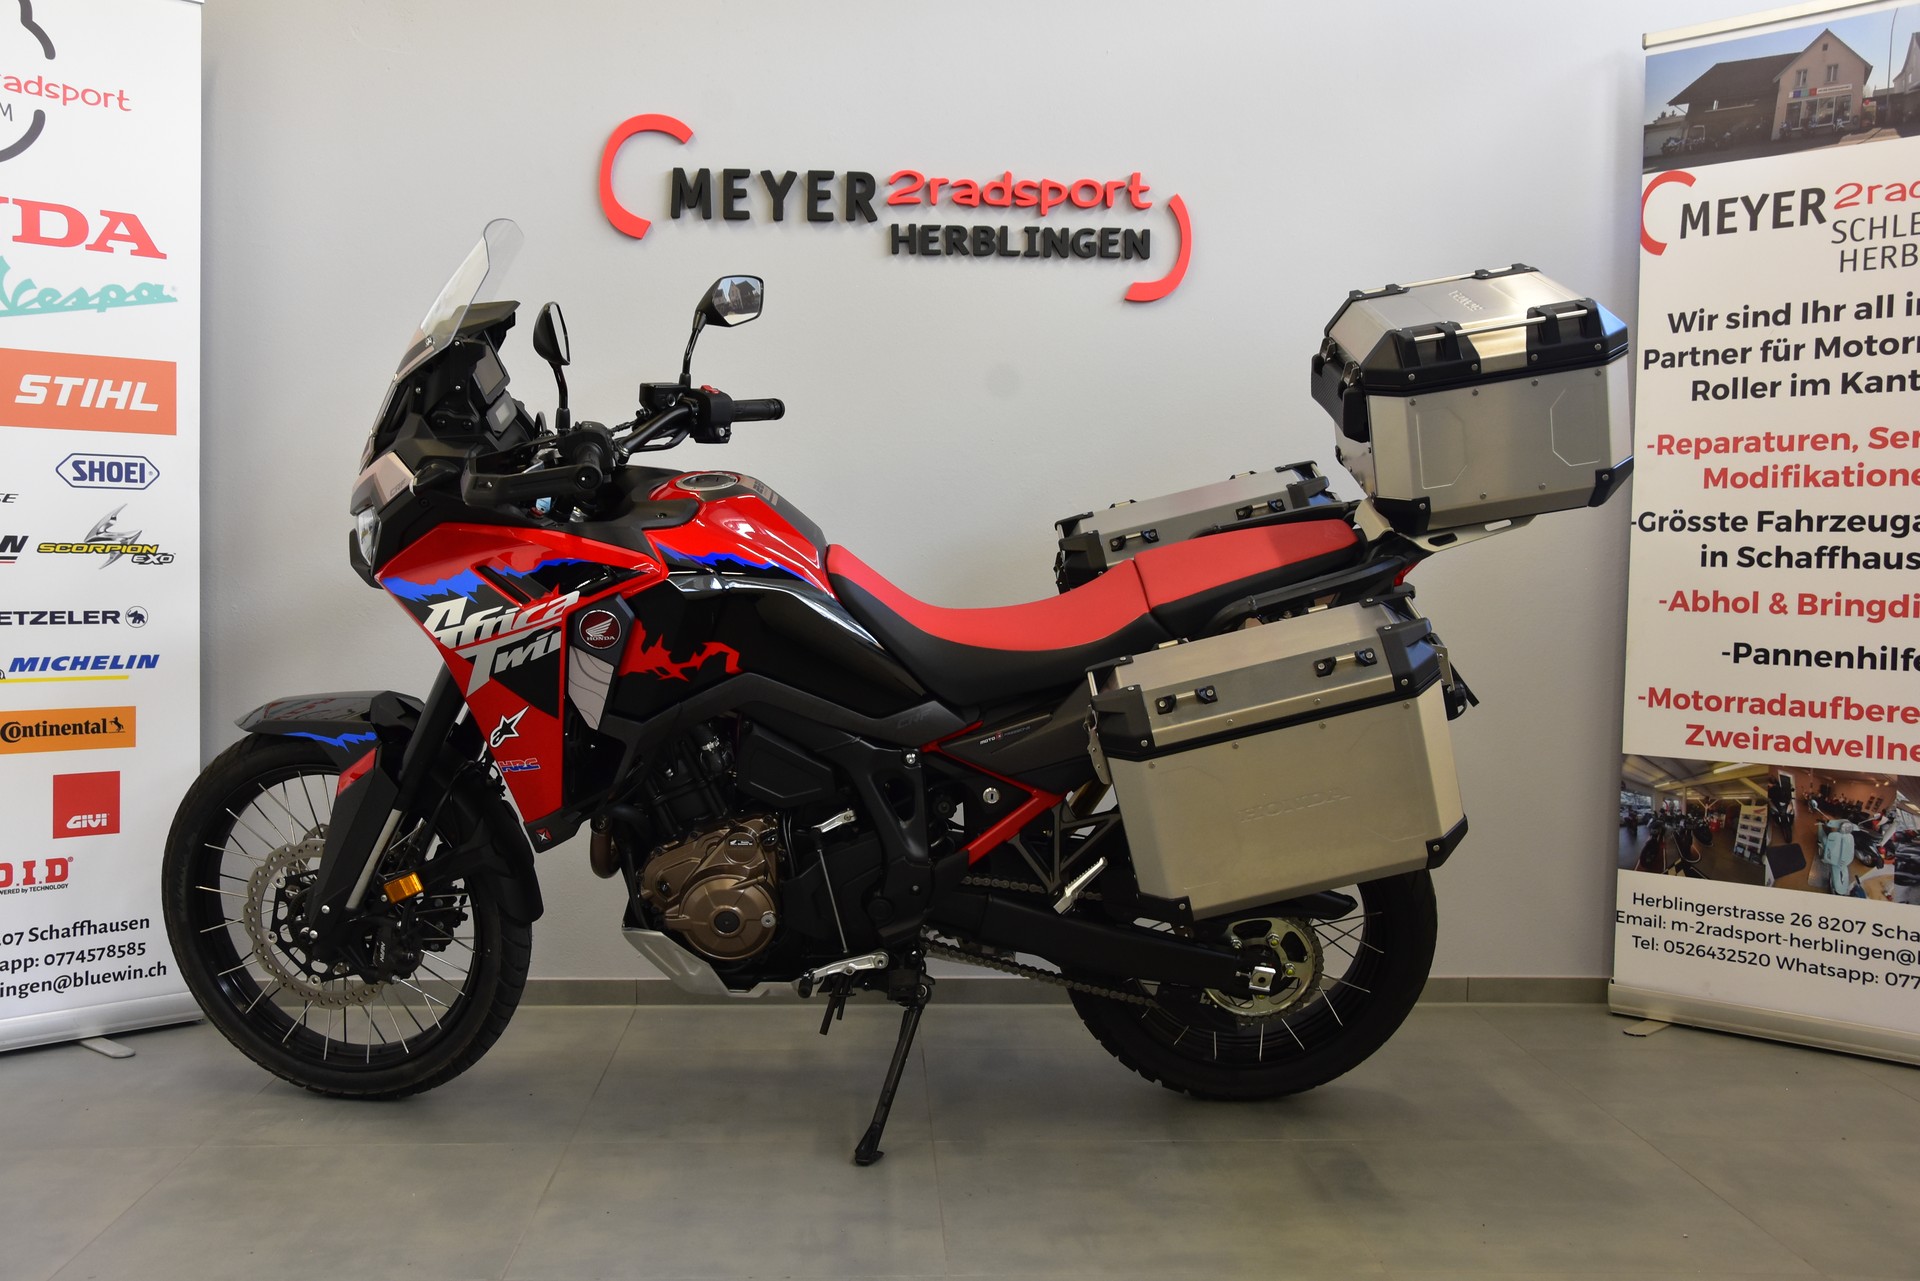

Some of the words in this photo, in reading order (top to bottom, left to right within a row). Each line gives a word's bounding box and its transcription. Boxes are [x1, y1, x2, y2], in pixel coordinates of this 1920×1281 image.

[0, 75, 132, 111] adsport
[670, 167, 878, 222] MEYER
[887, 170, 1152, 216] 2radsport
[0, 196, 167, 259] DA
[1680, 187, 1827, 239] MEYER
[890, 223, 1151, 259] HERBLINGEN
[1839, 243, 1919, 273] HERB
[1667, 308, 1719, 334] Wir
[1725, 302, 1791, 330] sind
[1801, 300, 1847, 324] Ihr
[1854, 294, 1894, 320] all
[1905, 291, 1920, 317] i
[1643, 345, 1752, 370] Partner
[1760, 338, 1805, 363] für
[1814, 334, 1920, 359] Motor
[14, 374, 159, 412] STIHL
[1691, 376, 1781, 402] Roller
[1790, 373, 1830, 397] im
[1841, 369, 1920, 395] Kant
[1647, 431, 1859, 460] -Reparaturen,
[72, 460, 146, 484] SHOEI
[1631, 509, 1749, 533] -Grösste
[37, 543, 159, 554] SCORPION
[1700, 544, 1728, 568] in
[1736, 545, 1920, 570] Schaffhaus
[423, 591, 580, 649] Africa
[1659, 589, 1759, 614] -Abhol
[1768, 592, 1788, 615] &
[1798, 591, 1920, 623] Bringdi
[9, 654, 160, 672] MICHELIN
[1638, 686, 1920, 724] -Motorradaufbere
[0, 718, 107, 743] Continental
[498, 758, 541, 772] HRC
[0, 931, 24, 946] 07
[28, 918, 150, 942] Schaffhausen
[1632, 892, 1785, 924] Herblingerstrasse
[1790, 912, 1812, 928] 26
[1818, 916, 1866, 935] 8207
[1871, 922, 1920, 942] Scha
[44, 942, 146, 966] 0774578585
[1615, 910, 1666, 930] Email:
[1671, 918, 1920, 966] m-2radsport-herblingen@
[1632, 935, 1659, 951] Tel:
[1663, 940, 1771, 967] 0526432520
[1776, 955, 1879, 986] Whatsapp:
[1885, 972, 1920, 990] 077
